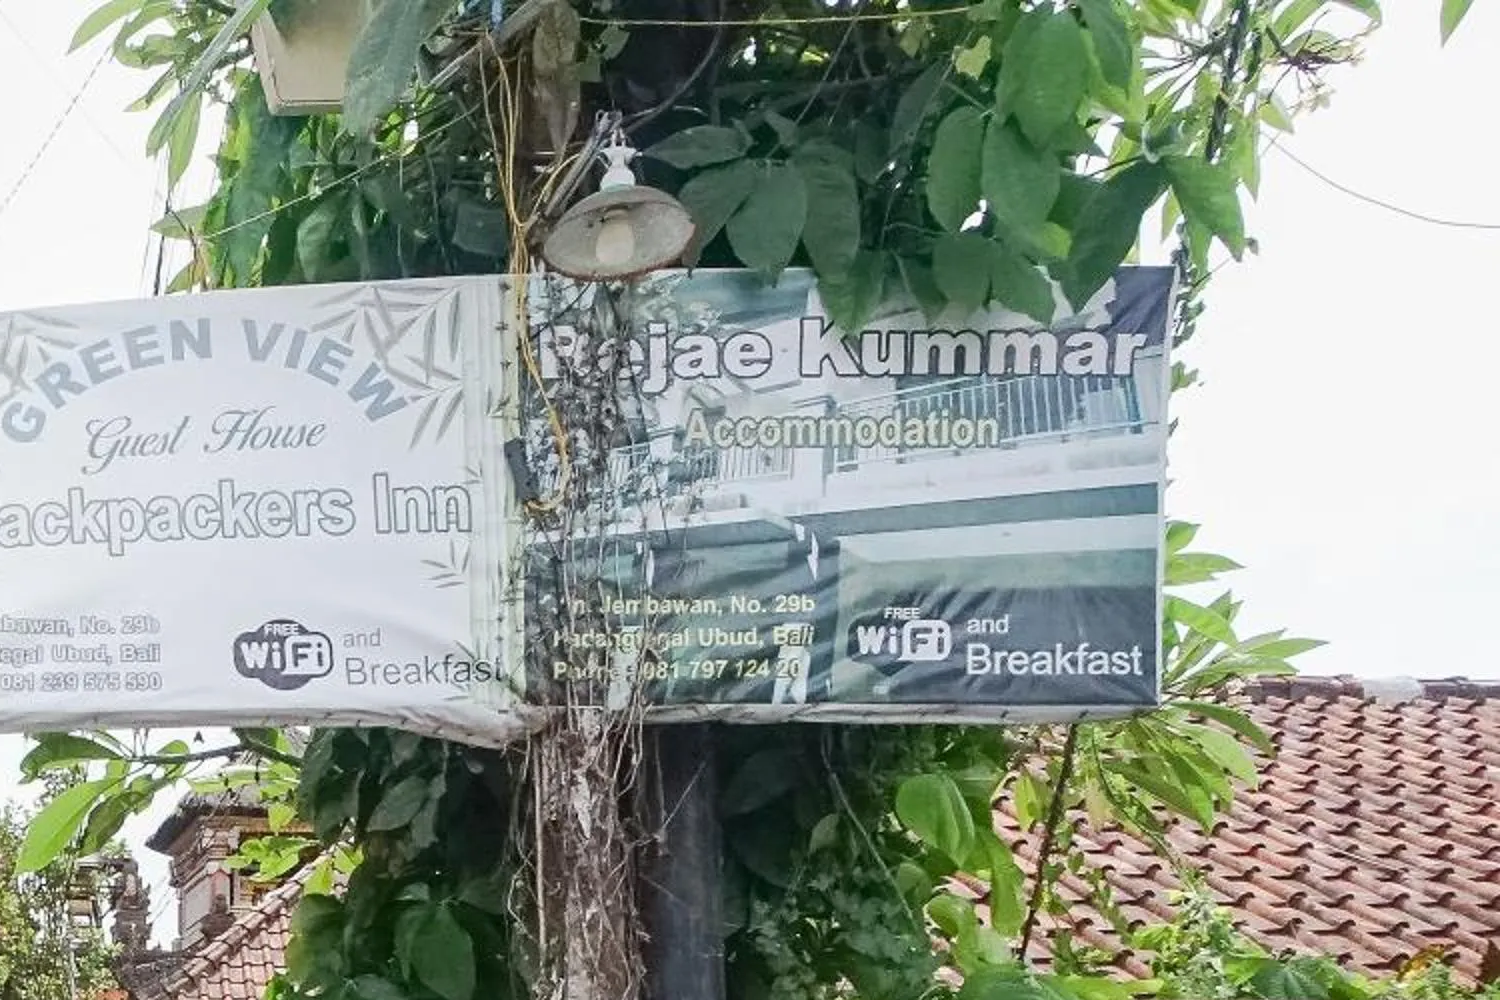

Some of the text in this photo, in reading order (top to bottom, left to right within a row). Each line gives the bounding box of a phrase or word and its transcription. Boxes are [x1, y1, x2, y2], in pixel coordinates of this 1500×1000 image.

[800, 316, 1147, 377] Kummar
[0, 317, 408, 443] GREEN VIEW
[685, 407, 1001, 448] Accommodation
[81, 405, 328, 476] Guest House
[372, 472, 474, 534] Inn
[731, 596, 767, 614] No.
[775, 594, 816, 613] 29b
[884, 607, 921, 620] FREE
[79, 616, 117, 635] No.
[264, 623, 300, 636] FREE
[966, 614, 1009, 634] and
[343, 628, 382, 648] and
[698, 627, 764, 648] Ubud,
[772, 626, 815, 646] Bali
[51, 644, 113, 665] Ubud,
[119, 644, 161, 663] Bali
[966, 642, 1144, 676] Breakfast
[345, 654, 506, 685] Breakfast
[642, 661, 679, 680] 081
[689, 660, 728, 679] 797
[735, 659, 770, 678] 124
[0, 672, 35, 691] 081
